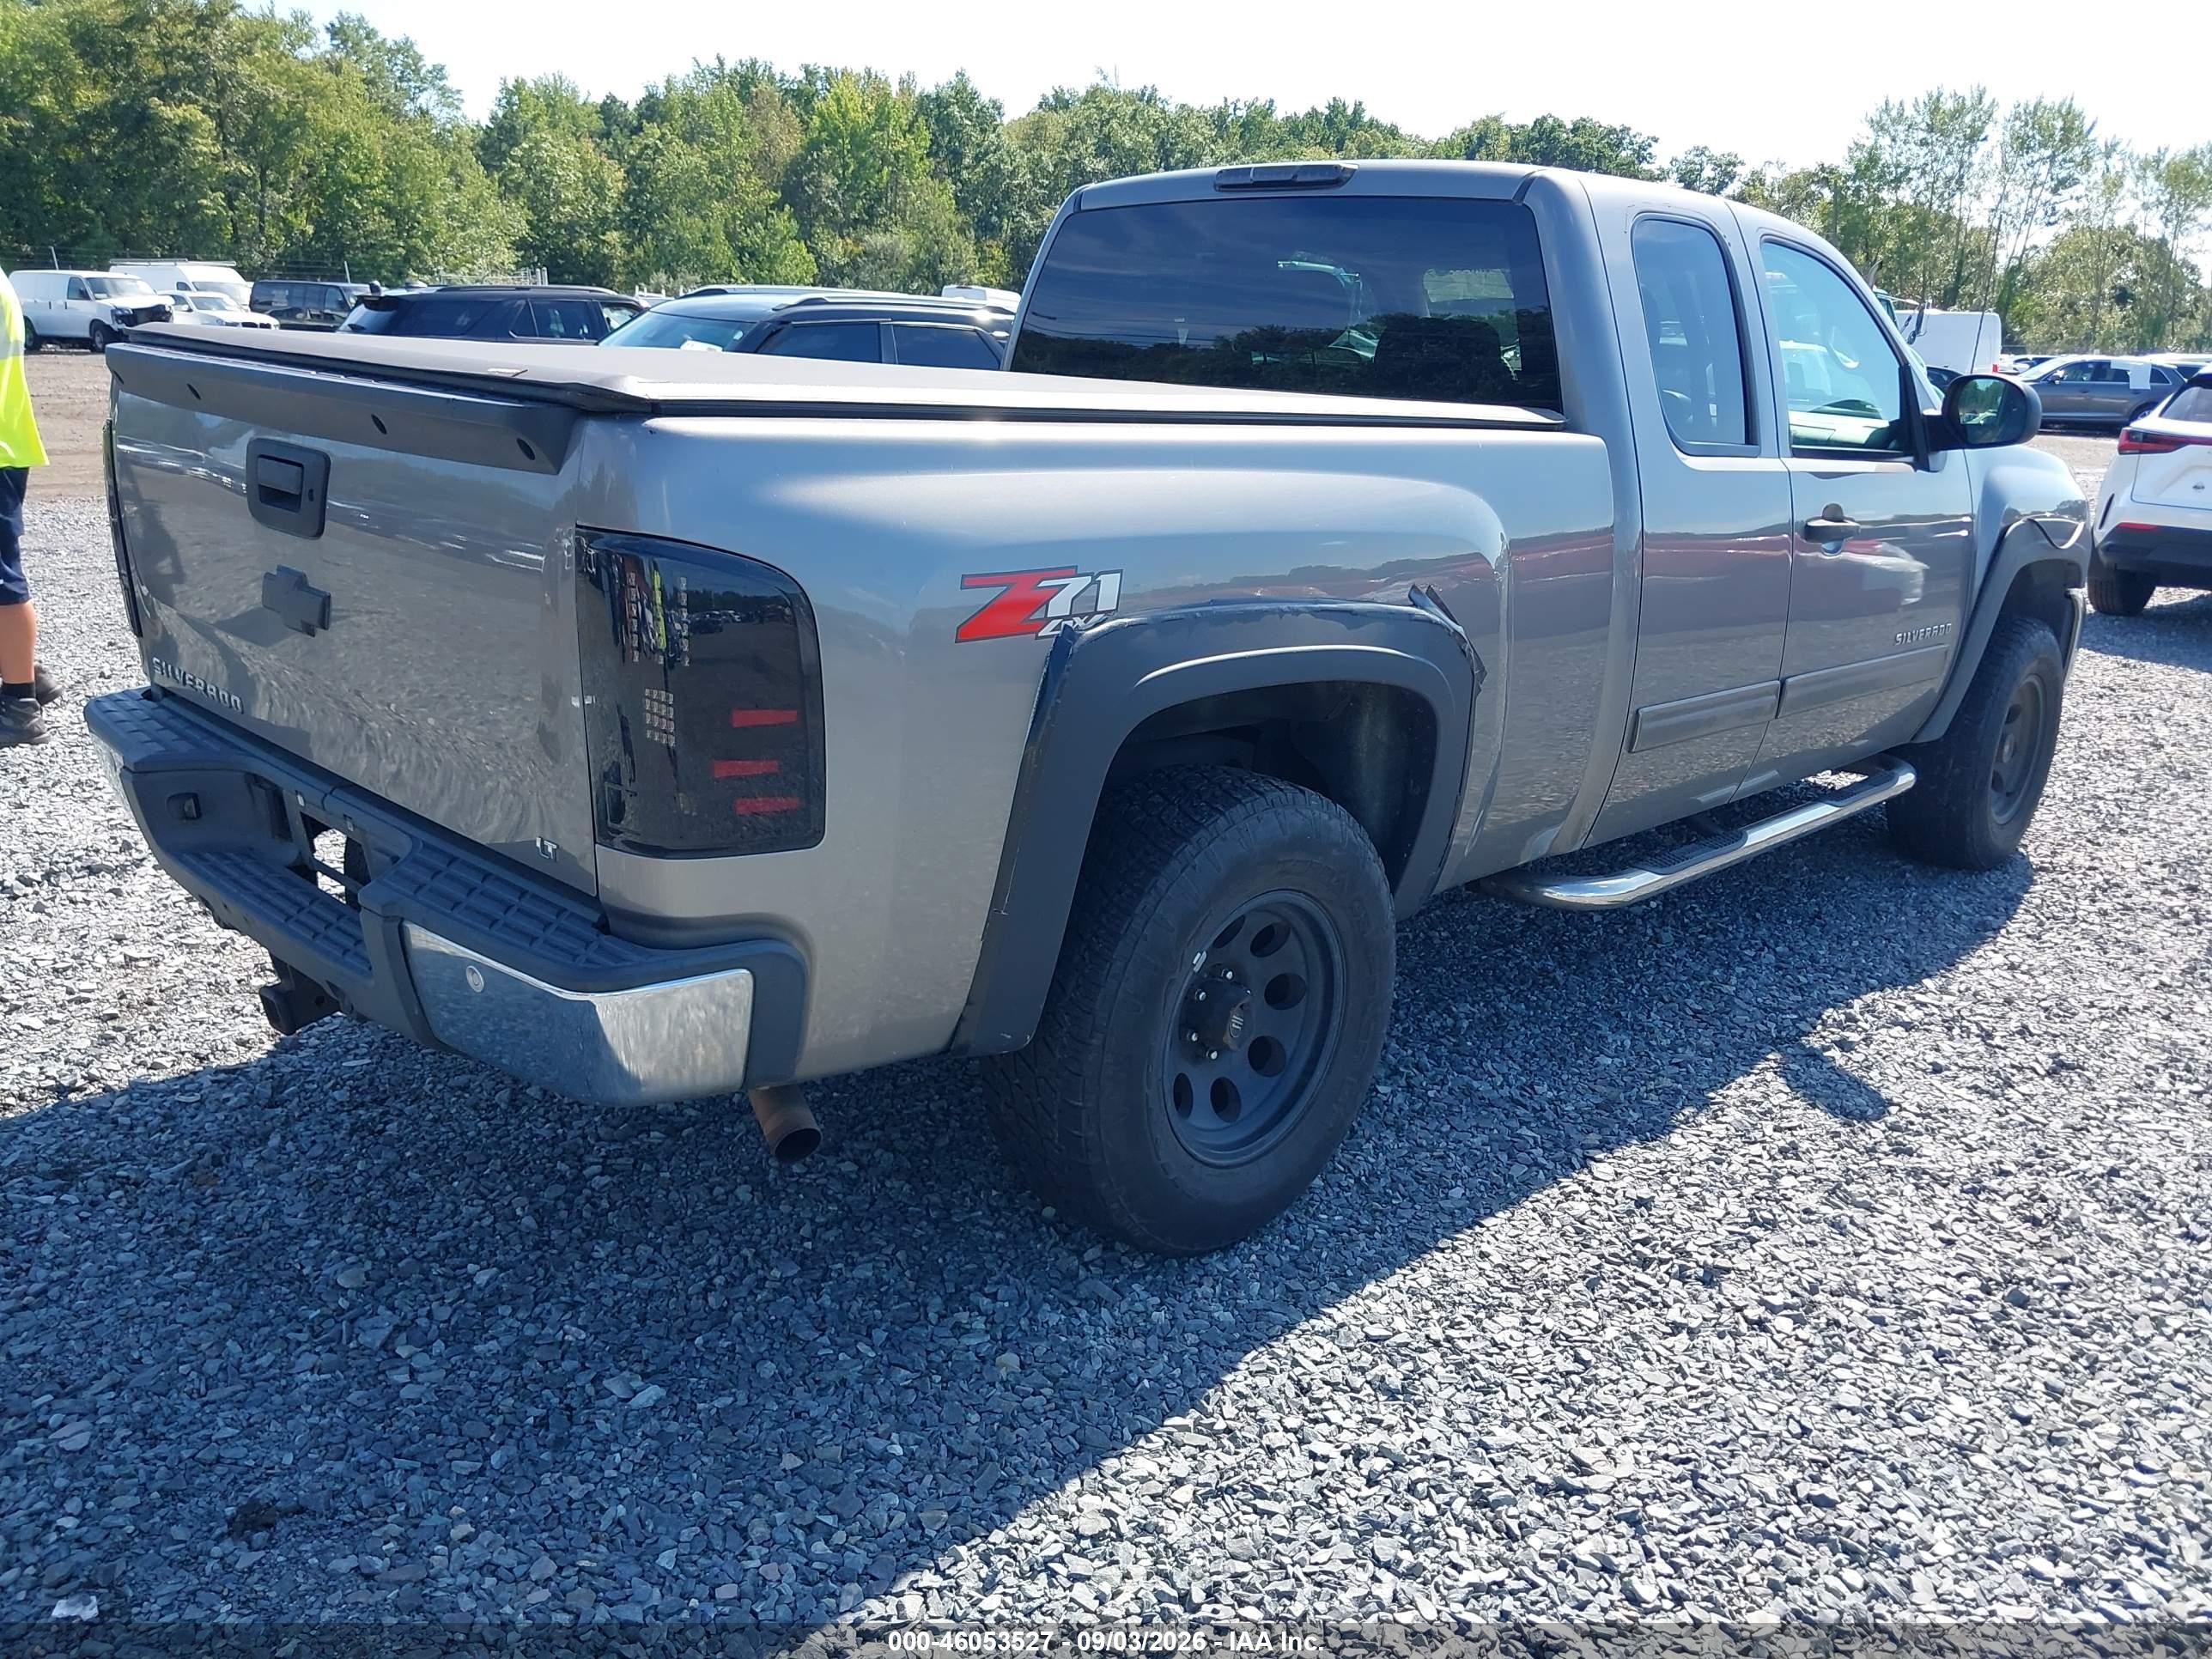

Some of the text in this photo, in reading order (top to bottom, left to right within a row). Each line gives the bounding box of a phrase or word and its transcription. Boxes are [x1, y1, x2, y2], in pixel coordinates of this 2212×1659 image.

[955, 565, 1123, 642] Z71
[1895, 623, 1952, 646] SILVERADO
[152, 656, 244, 714] SILVERADO
[536, 837, 557, 860] LT
